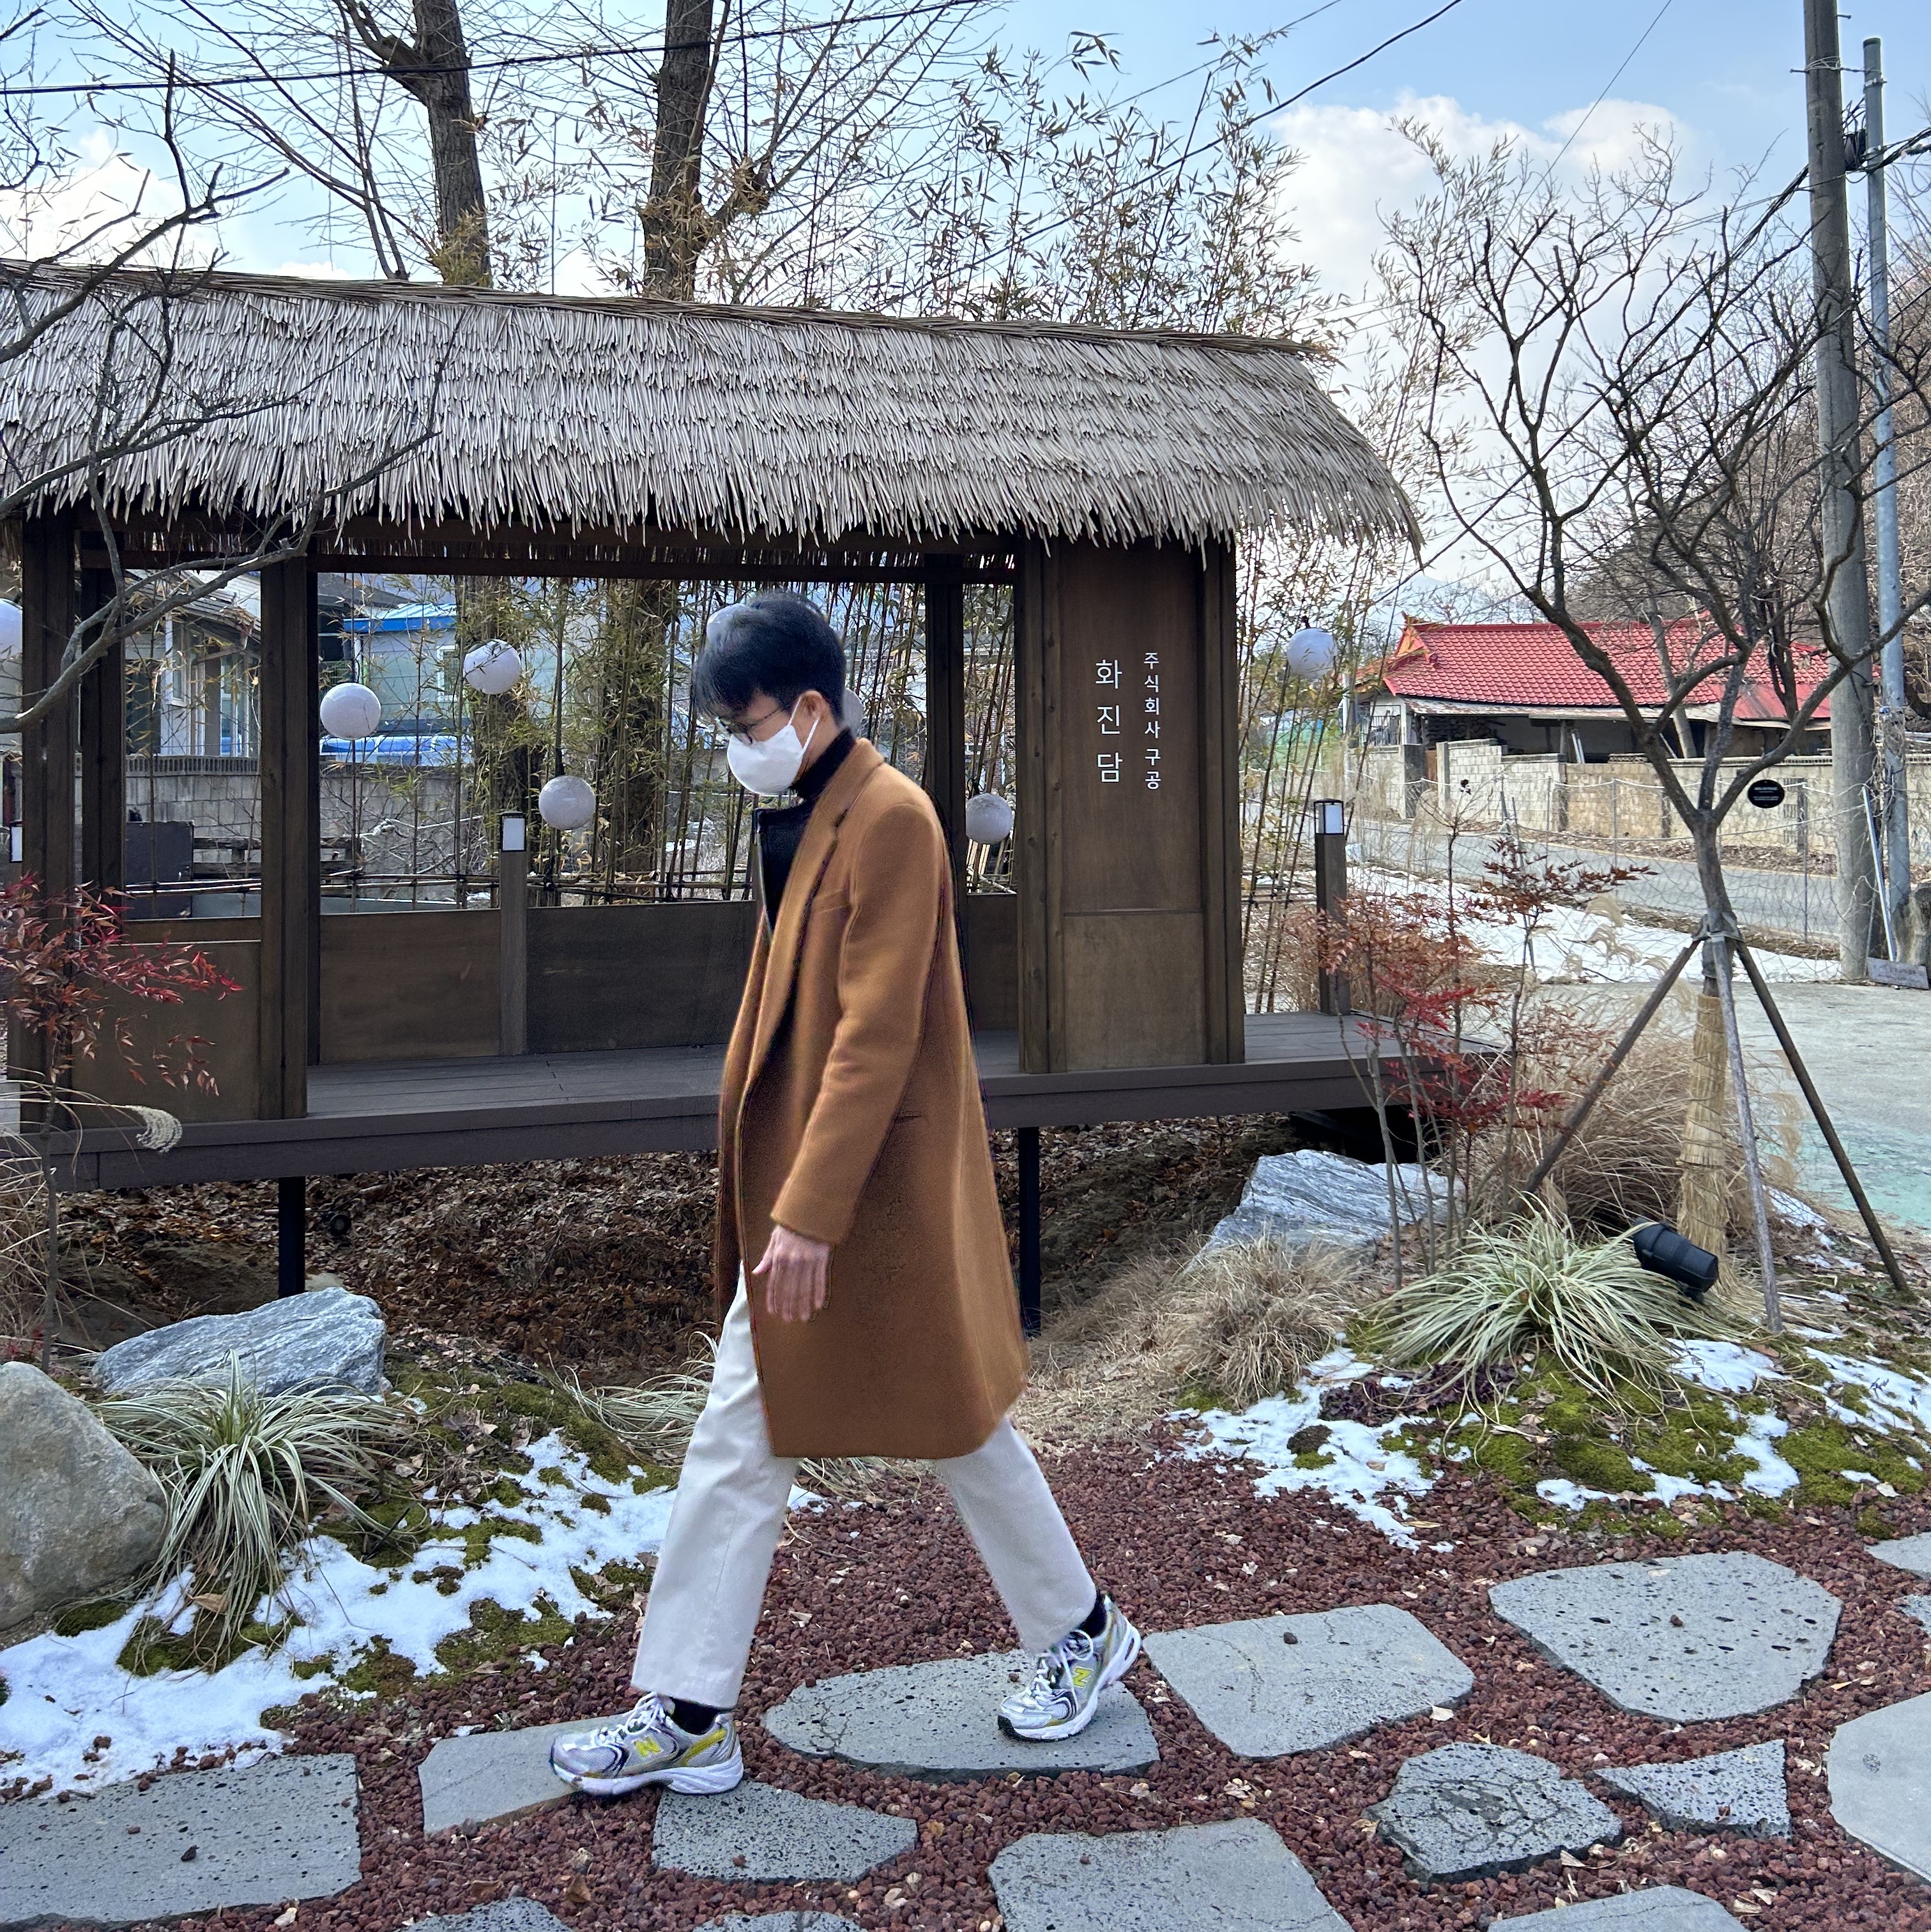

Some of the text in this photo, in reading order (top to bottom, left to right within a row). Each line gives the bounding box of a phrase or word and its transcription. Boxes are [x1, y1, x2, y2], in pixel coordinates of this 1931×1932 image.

[1095, 659, 1123, 782] 화진담
[1143, 652, 1161, 789] 주식회사 구공
